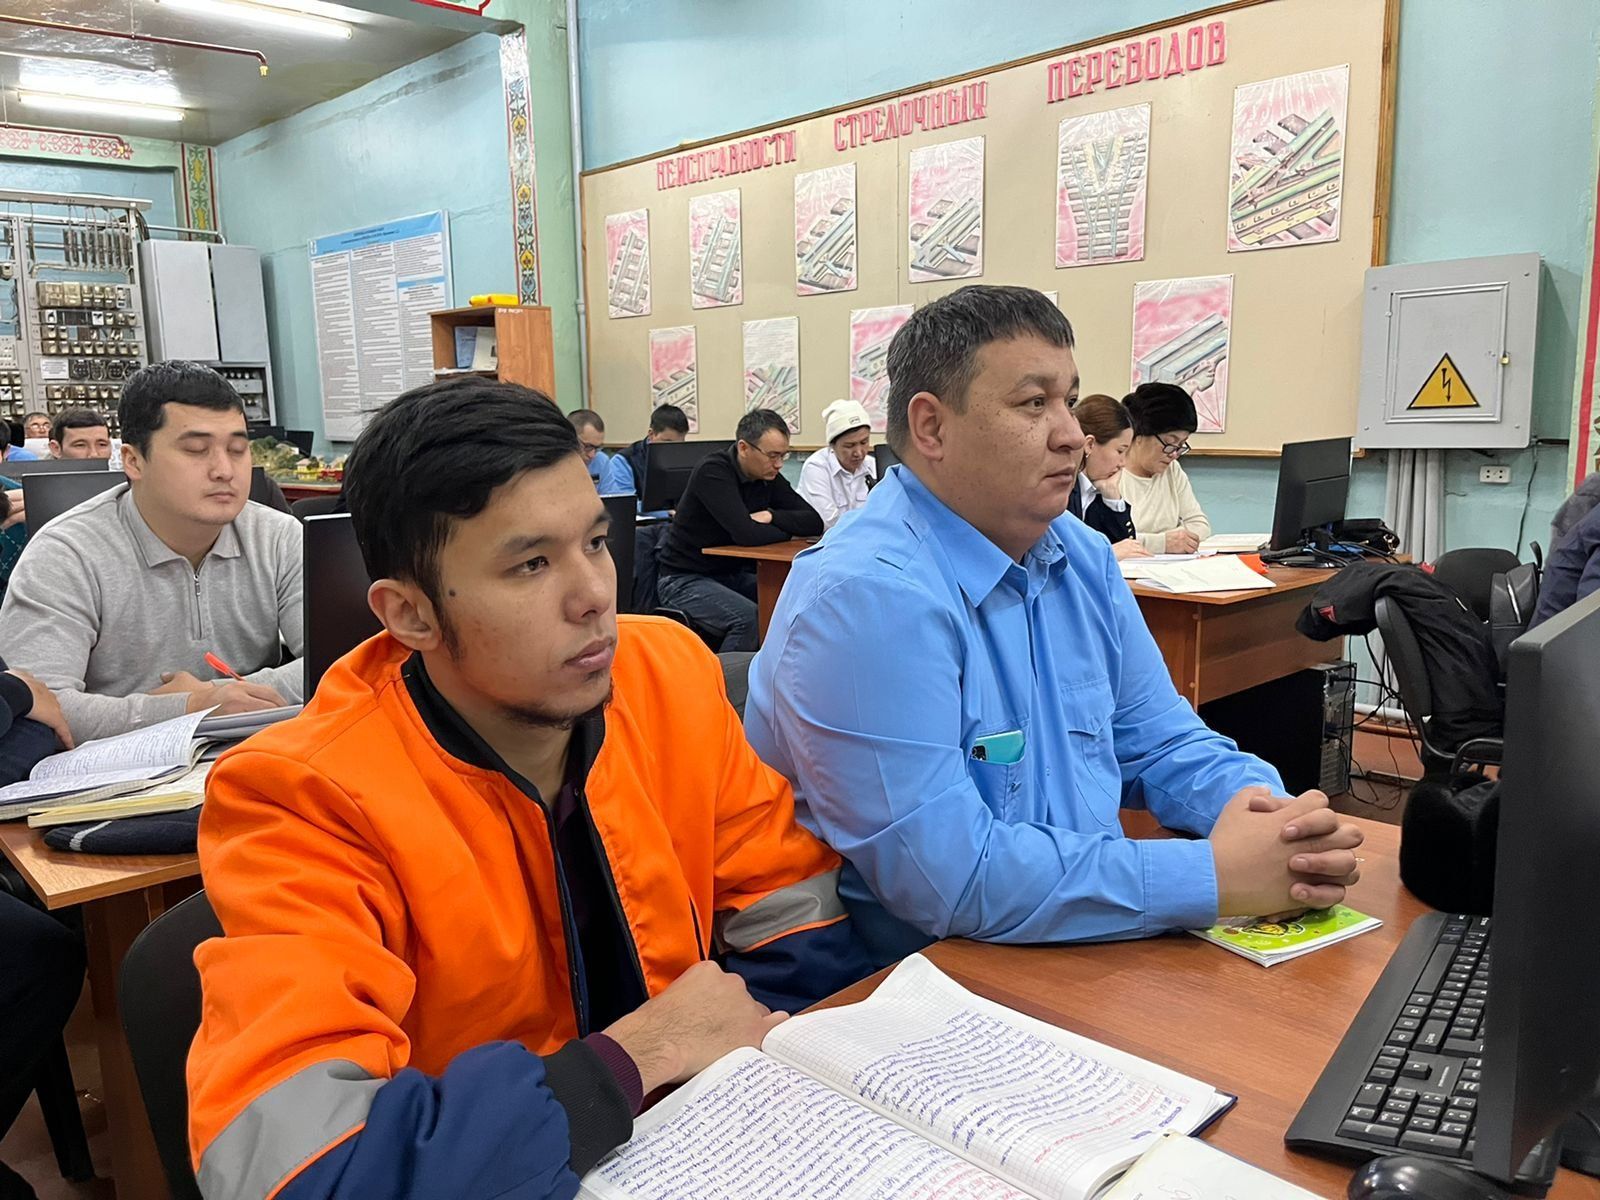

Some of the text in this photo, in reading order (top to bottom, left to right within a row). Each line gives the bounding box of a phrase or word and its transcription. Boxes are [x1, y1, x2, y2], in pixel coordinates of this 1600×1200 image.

[656, 21, 1227, 190] НЕИСПРАВНОСТИ СТРЕЛОЧНЫХ ПЕРЕВОДОВ
